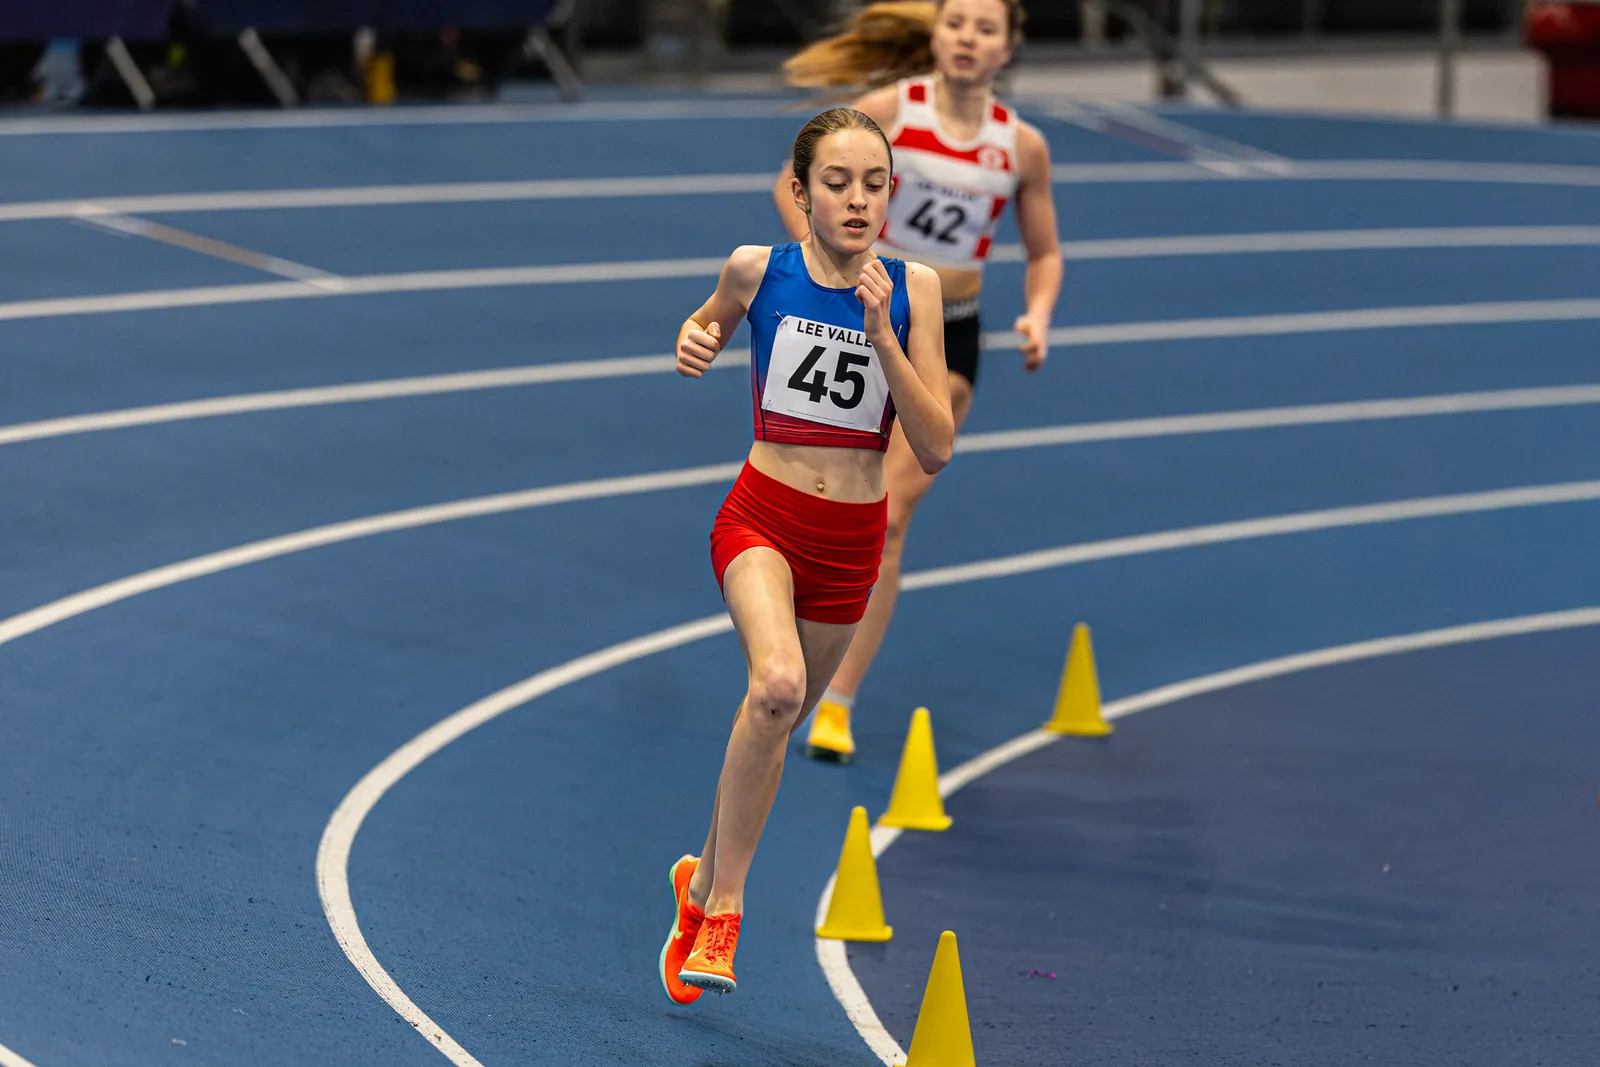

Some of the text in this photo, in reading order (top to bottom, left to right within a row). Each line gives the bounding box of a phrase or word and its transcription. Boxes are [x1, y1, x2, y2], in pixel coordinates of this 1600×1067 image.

[907, 199, 967, 244] 42
[796, 320, 825, 338] LEE
[787, 345, 870, 410] 45
